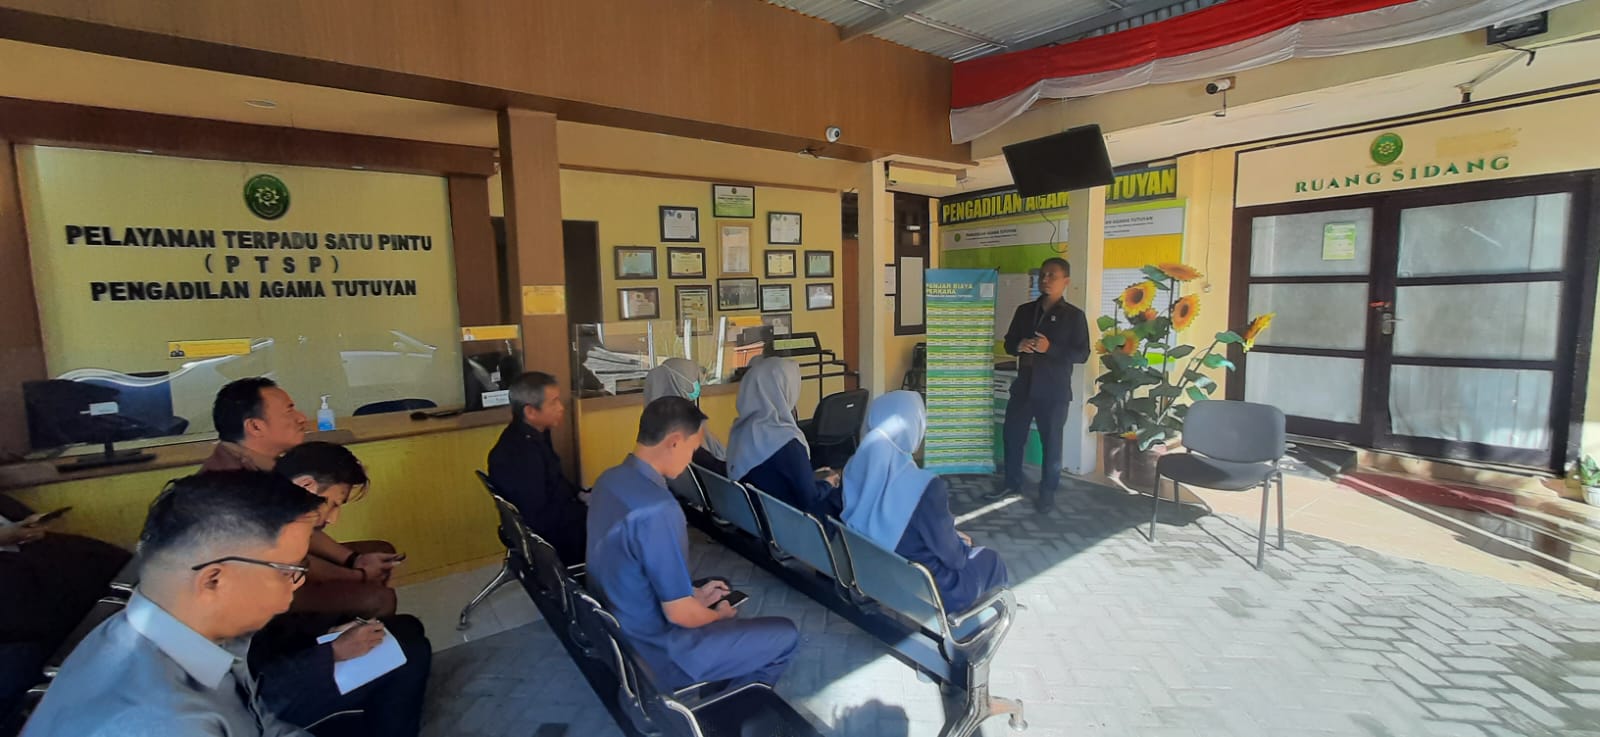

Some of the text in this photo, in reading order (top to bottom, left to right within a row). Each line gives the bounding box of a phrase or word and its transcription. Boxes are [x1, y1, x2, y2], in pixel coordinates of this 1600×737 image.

[1295, 155, 1510, 193] RUANG SIDANG
[942, 191, 1023, 223] PENGADILAN
[1024, 191, 1070, 212] AGAM
[65, 225, 432, 251] PELAYANAN TERPADU SATU PINTU
[90, 279, 417, 301] PENGADILAN AGAMA TUTUYAN
